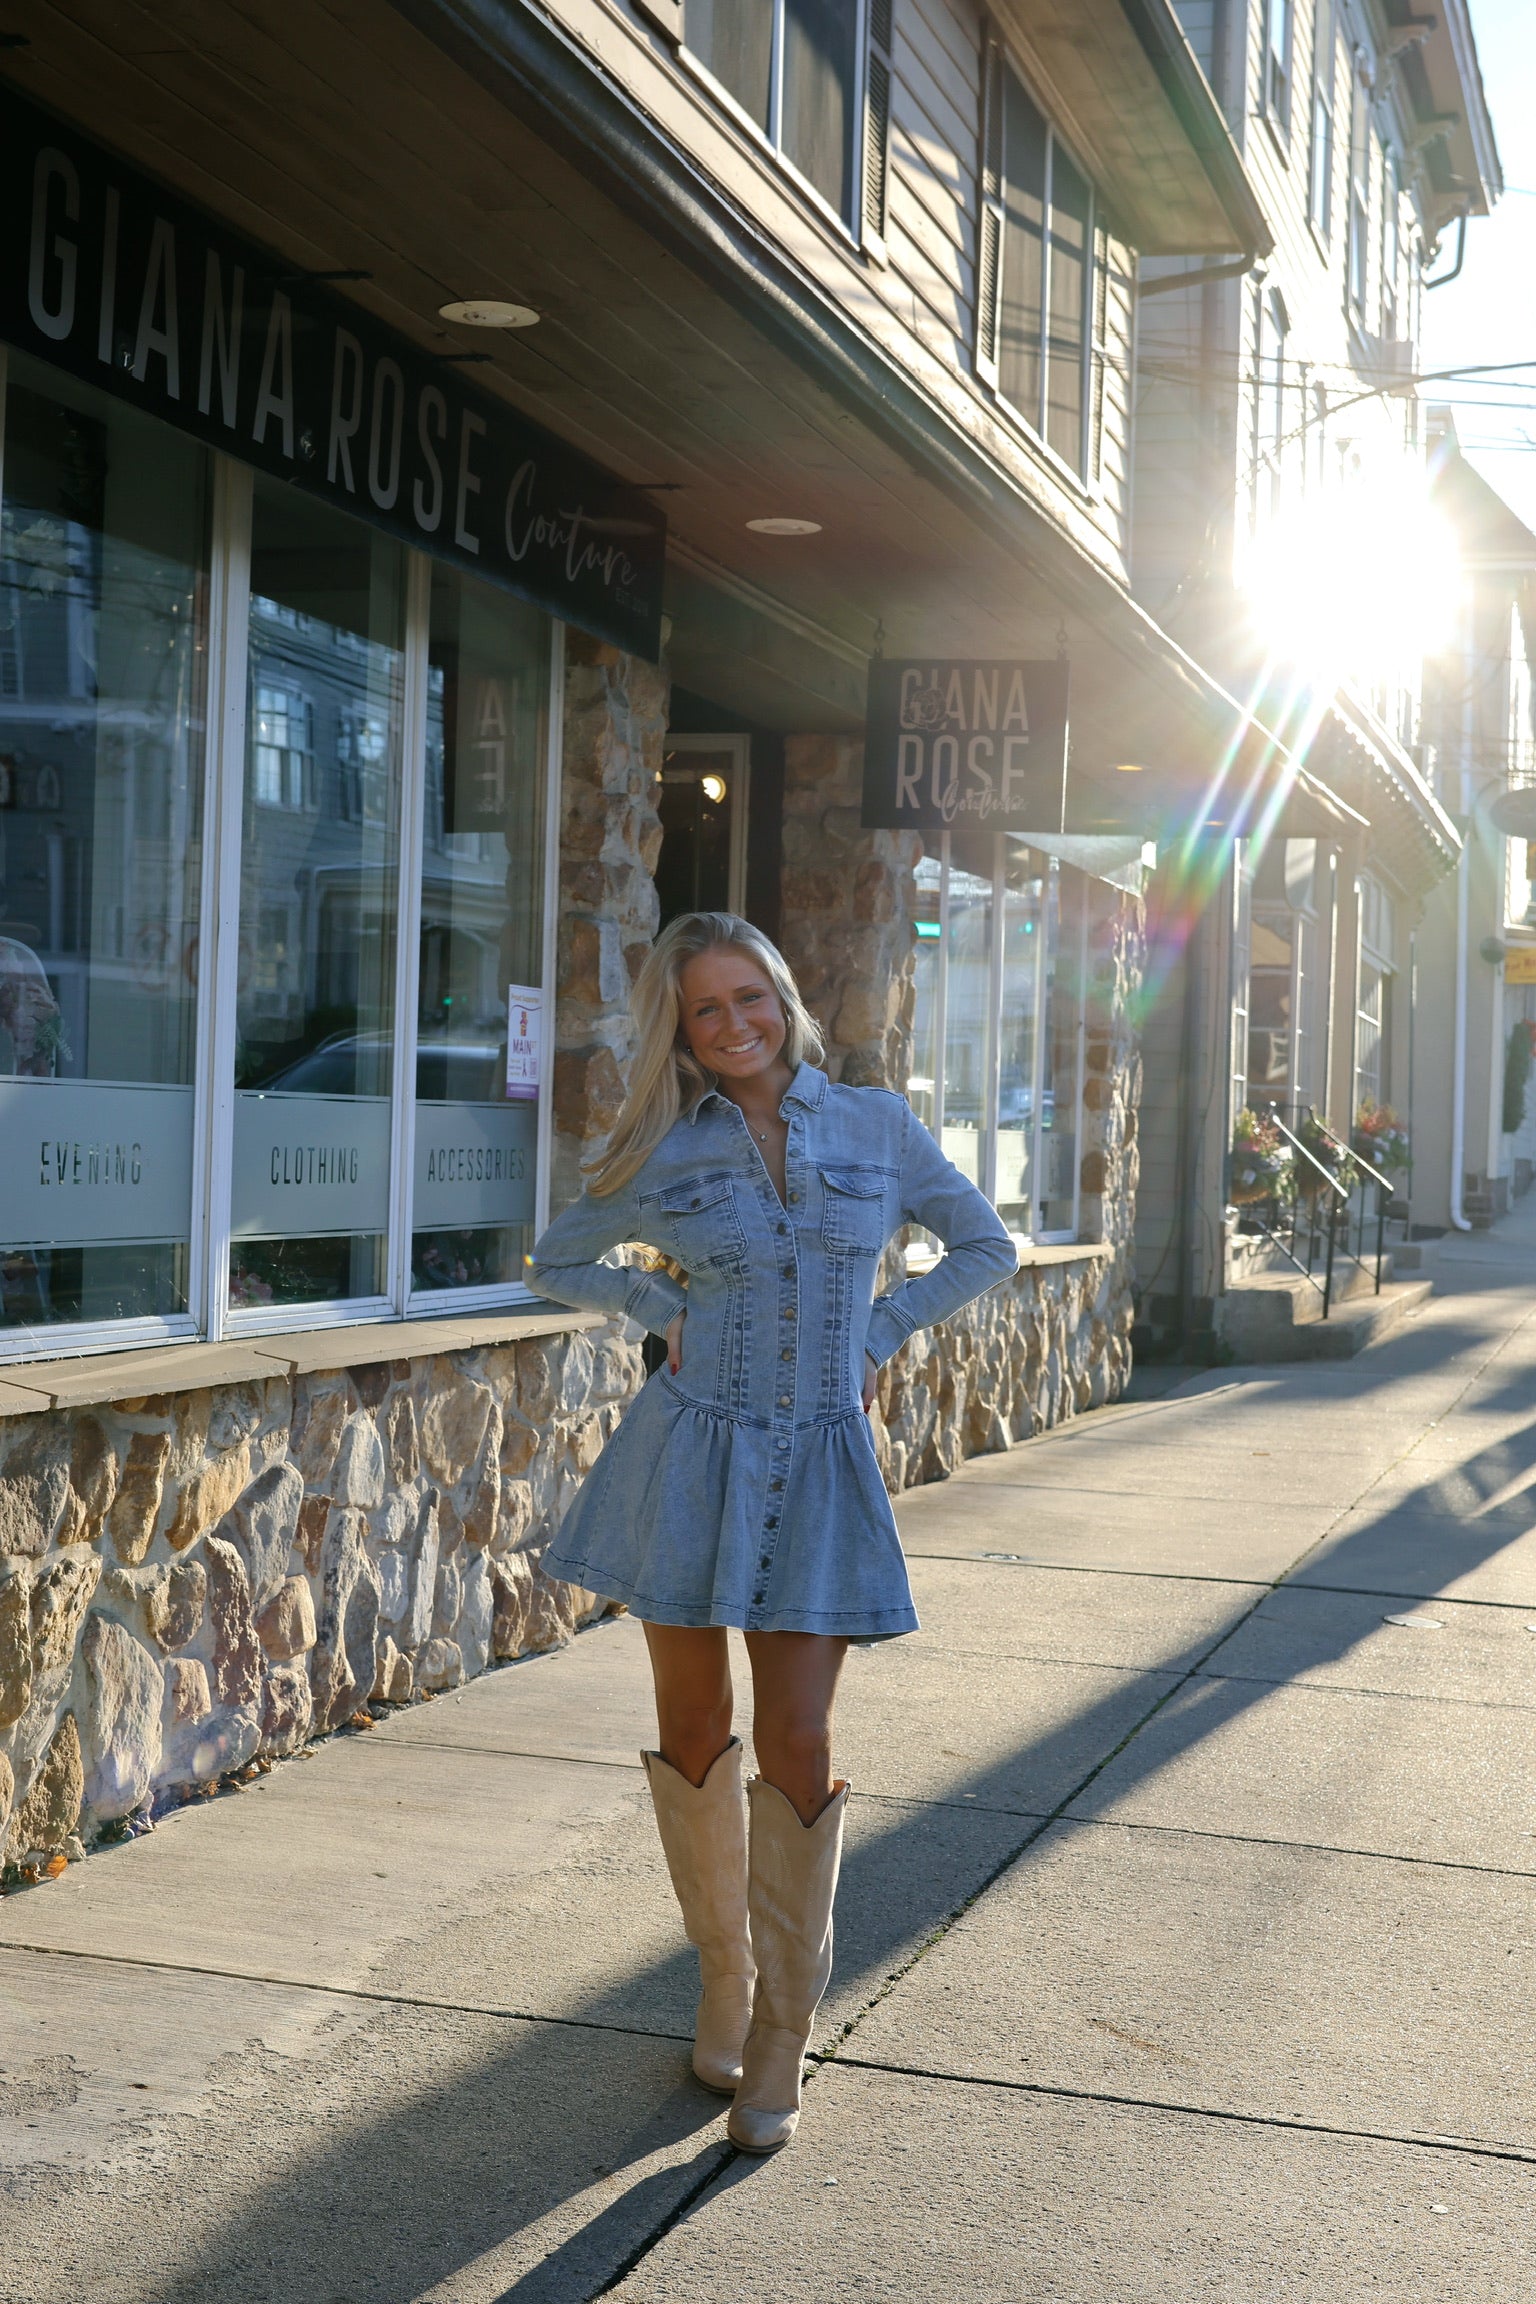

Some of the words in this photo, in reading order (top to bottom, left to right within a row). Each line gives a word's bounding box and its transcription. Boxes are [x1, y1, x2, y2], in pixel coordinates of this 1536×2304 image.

[28, 146, 294, 460] GIANA
[327, 325, 487, 556] ROSE
[505, 459, 638, 587] Couture
[895, 734, 1030, 810] ROSE
[513, 1038, 531, 1055] MAIN
[40, 1141, 142, 1185] EVENING
[271, 1146, 358, 1185] CLOTHING
[428, 1148, 525, 1182] ACCESSORIES
